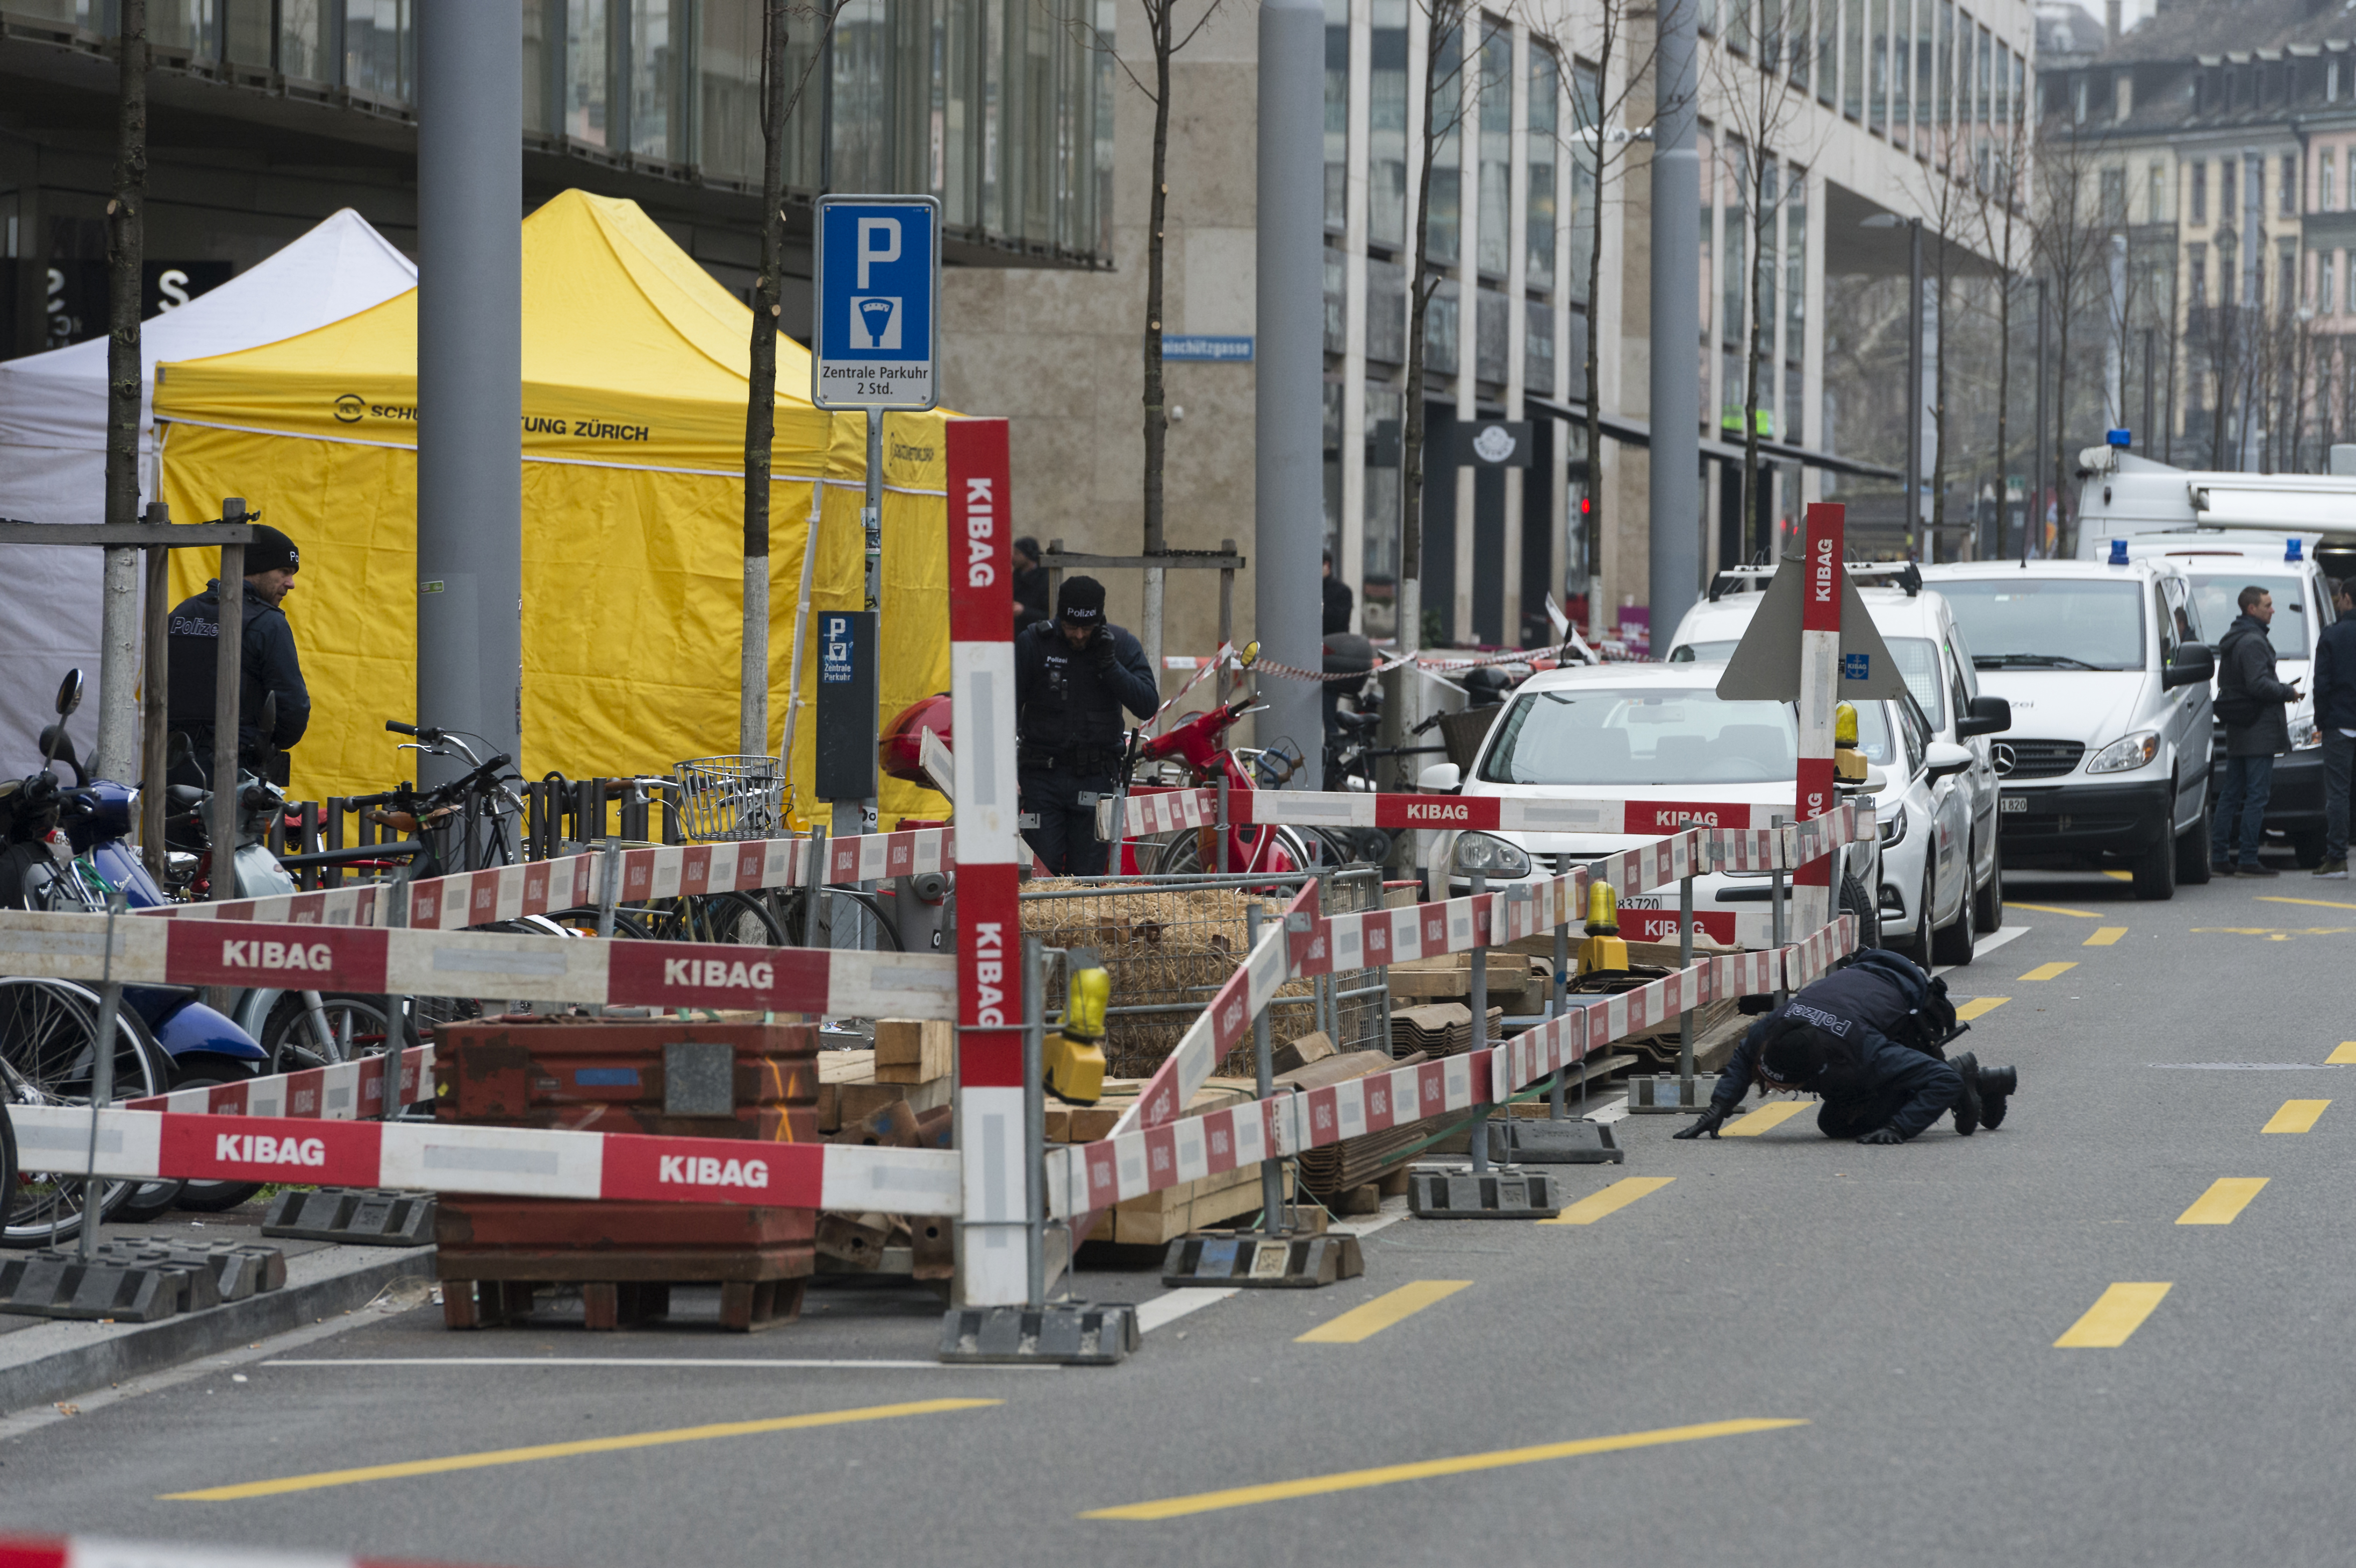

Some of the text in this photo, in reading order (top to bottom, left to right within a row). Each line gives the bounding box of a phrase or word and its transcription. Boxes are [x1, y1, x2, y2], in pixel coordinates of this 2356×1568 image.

[857, 217, 902, 289] P
[1163, 339, 1249, 357] eischützgasse
[823, 366, 928, 379] Zentrale Parkuhr
[857, 382, 893, 395] 2 Std.
[371, 404, 418, 421] SCHU
[574, 418, 649, 441] ZÜRICH
[967, 477, 994, 588] KIBAG
[1816, 539, 1833, 601] KIBAG
[1067, 607, 1097, 617] Polizei
[170, 616, 219, 636] Polize
[830, 618, 846, 642] P
[1407, 804, 1468, 820] KIBAG
[838, 851, 852, 870] KIBAG
[892, 846, 907, 864] KIBAG
[1645, 920, 1705, 936] KIBG
[223, 940, 332, 971] KIBAG
[664, 959, 774, 989] KIBAG
[976, 923, 1004, 1027] KIBAG
[1784, 1003, 1852, 1037] Polizei
[216, 1134, 325, 1166] KIBAG
[659, 1155, 769, 1188] KIBAG
